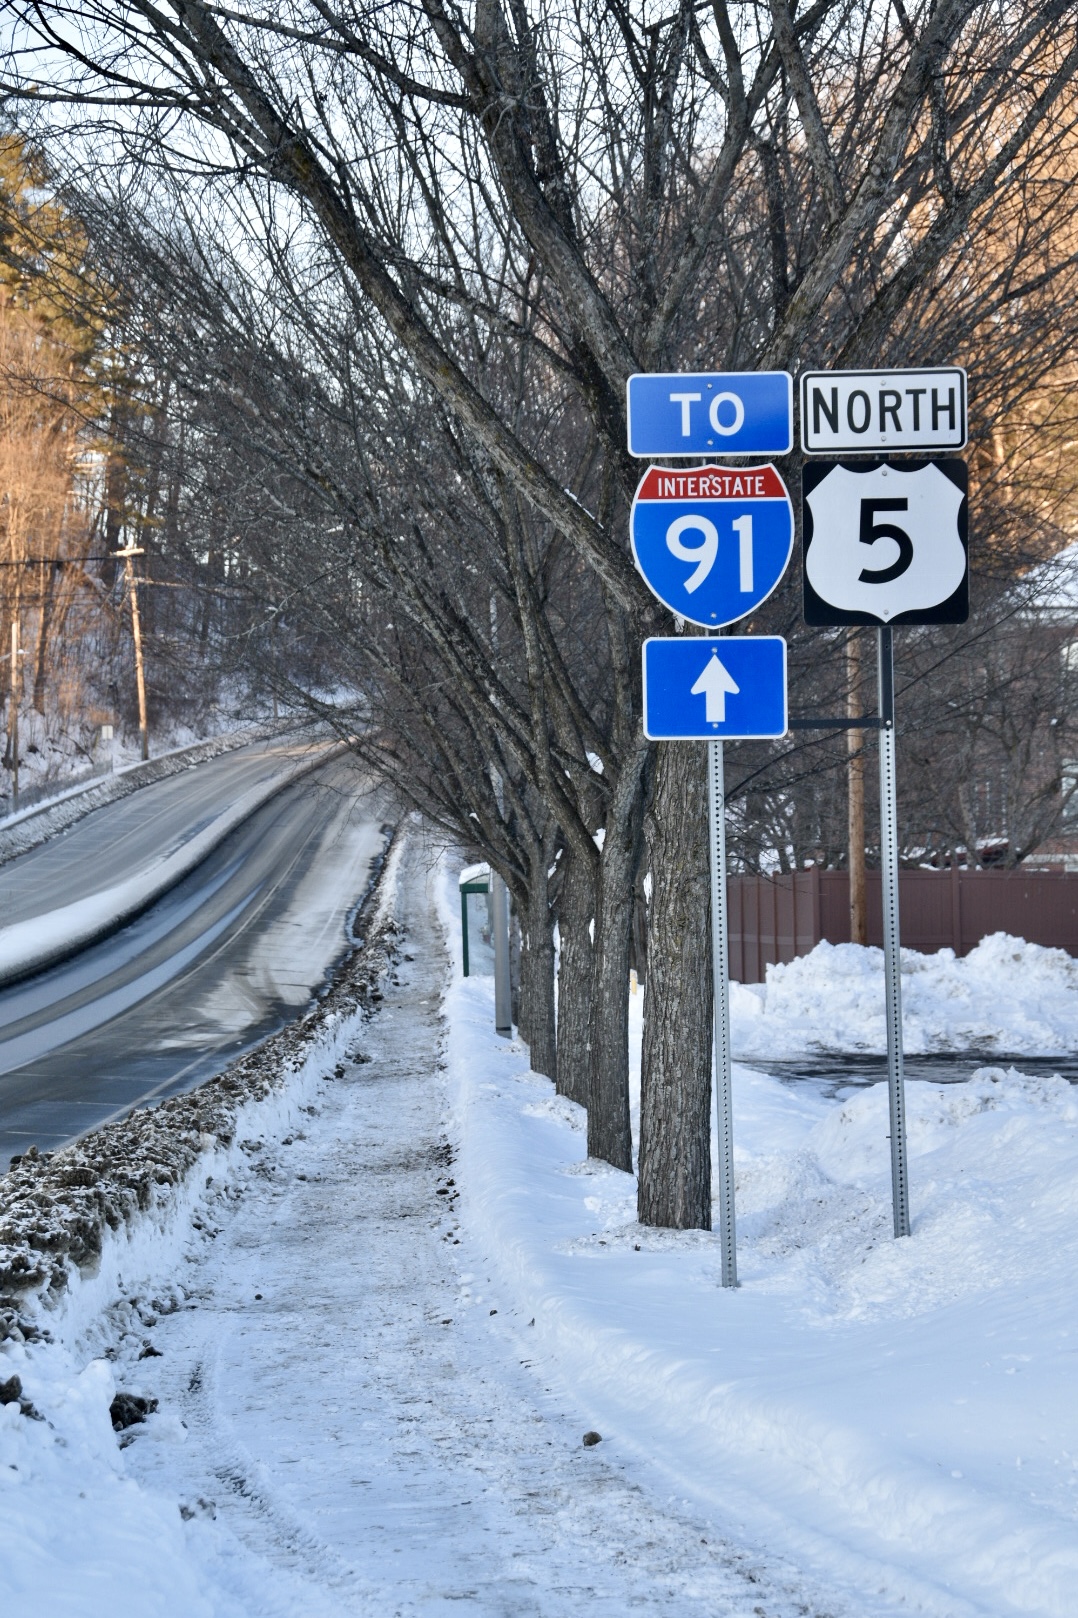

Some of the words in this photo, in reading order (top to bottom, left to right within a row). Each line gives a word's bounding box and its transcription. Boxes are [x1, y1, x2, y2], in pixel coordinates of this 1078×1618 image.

[670, 392, 745, 437] TO
[813, 387, 956, 434] NORTH
[657, 475, 766, 497] INTERSTATE
[665, 514, 754, 595] 91
[858, 497, 914, 584] 5
